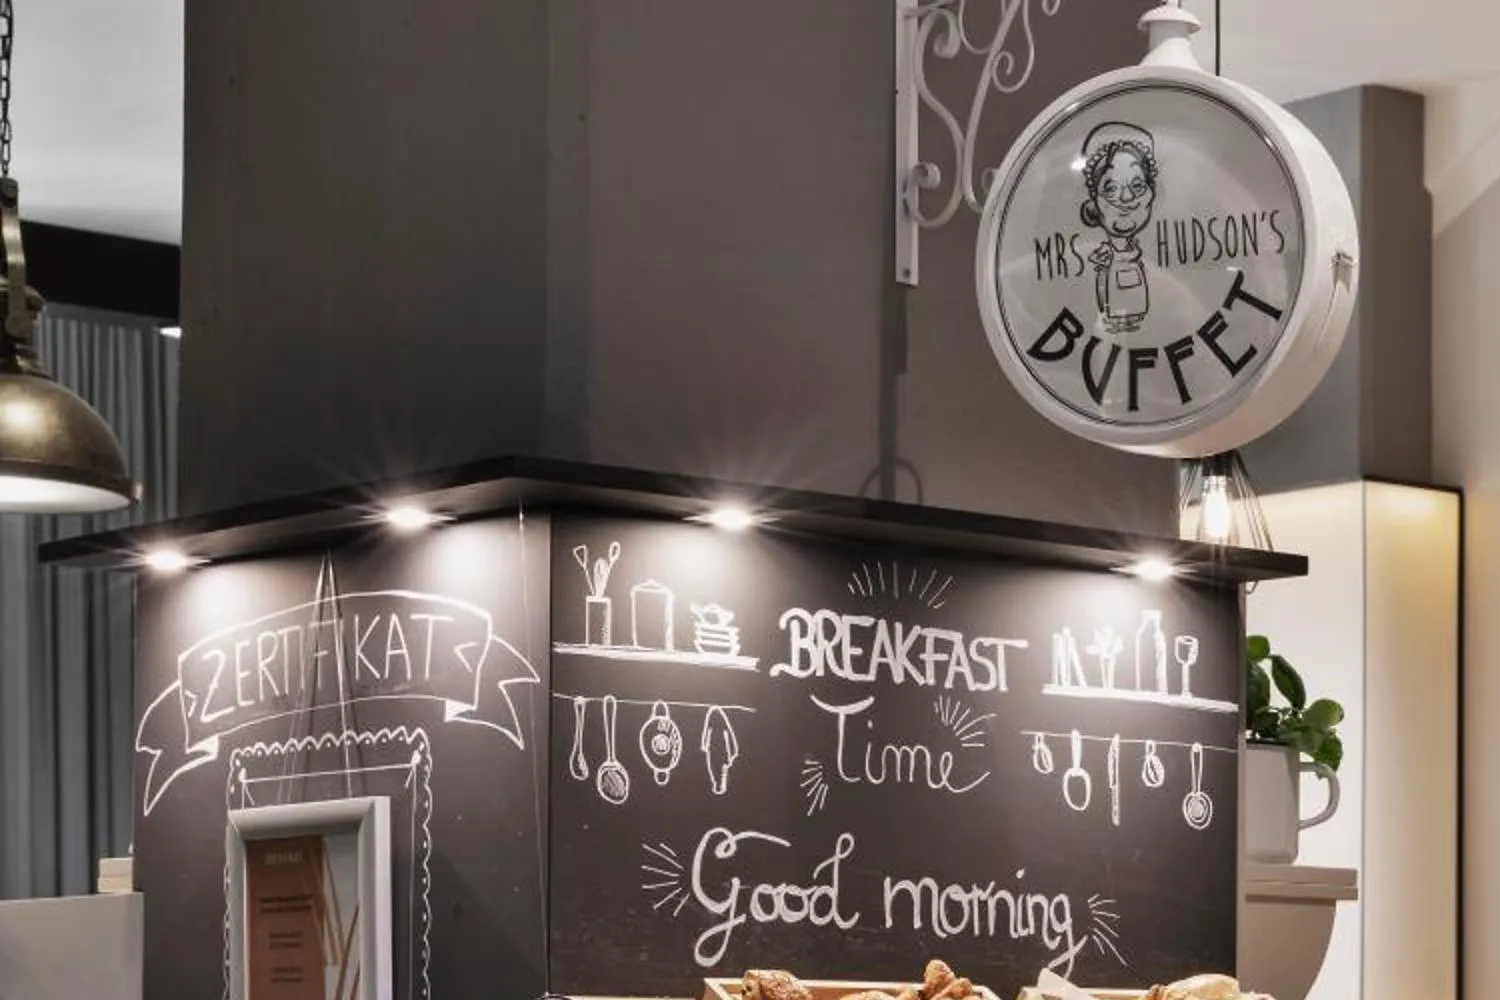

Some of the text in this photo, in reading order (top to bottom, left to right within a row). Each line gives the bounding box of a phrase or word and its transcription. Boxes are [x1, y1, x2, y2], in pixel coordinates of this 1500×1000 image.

[1034, 209, 1286, 281] MRS HUDSON'S
[1027, 270, 1283, 412] BUFFET
[200, 612, 455, 724] ZERTIFIKAT
[769, 606, 1028, 693] BREAKFAST
[810, 694, 991, 794] Time
[690, 826, 1088, 979] Good morning
